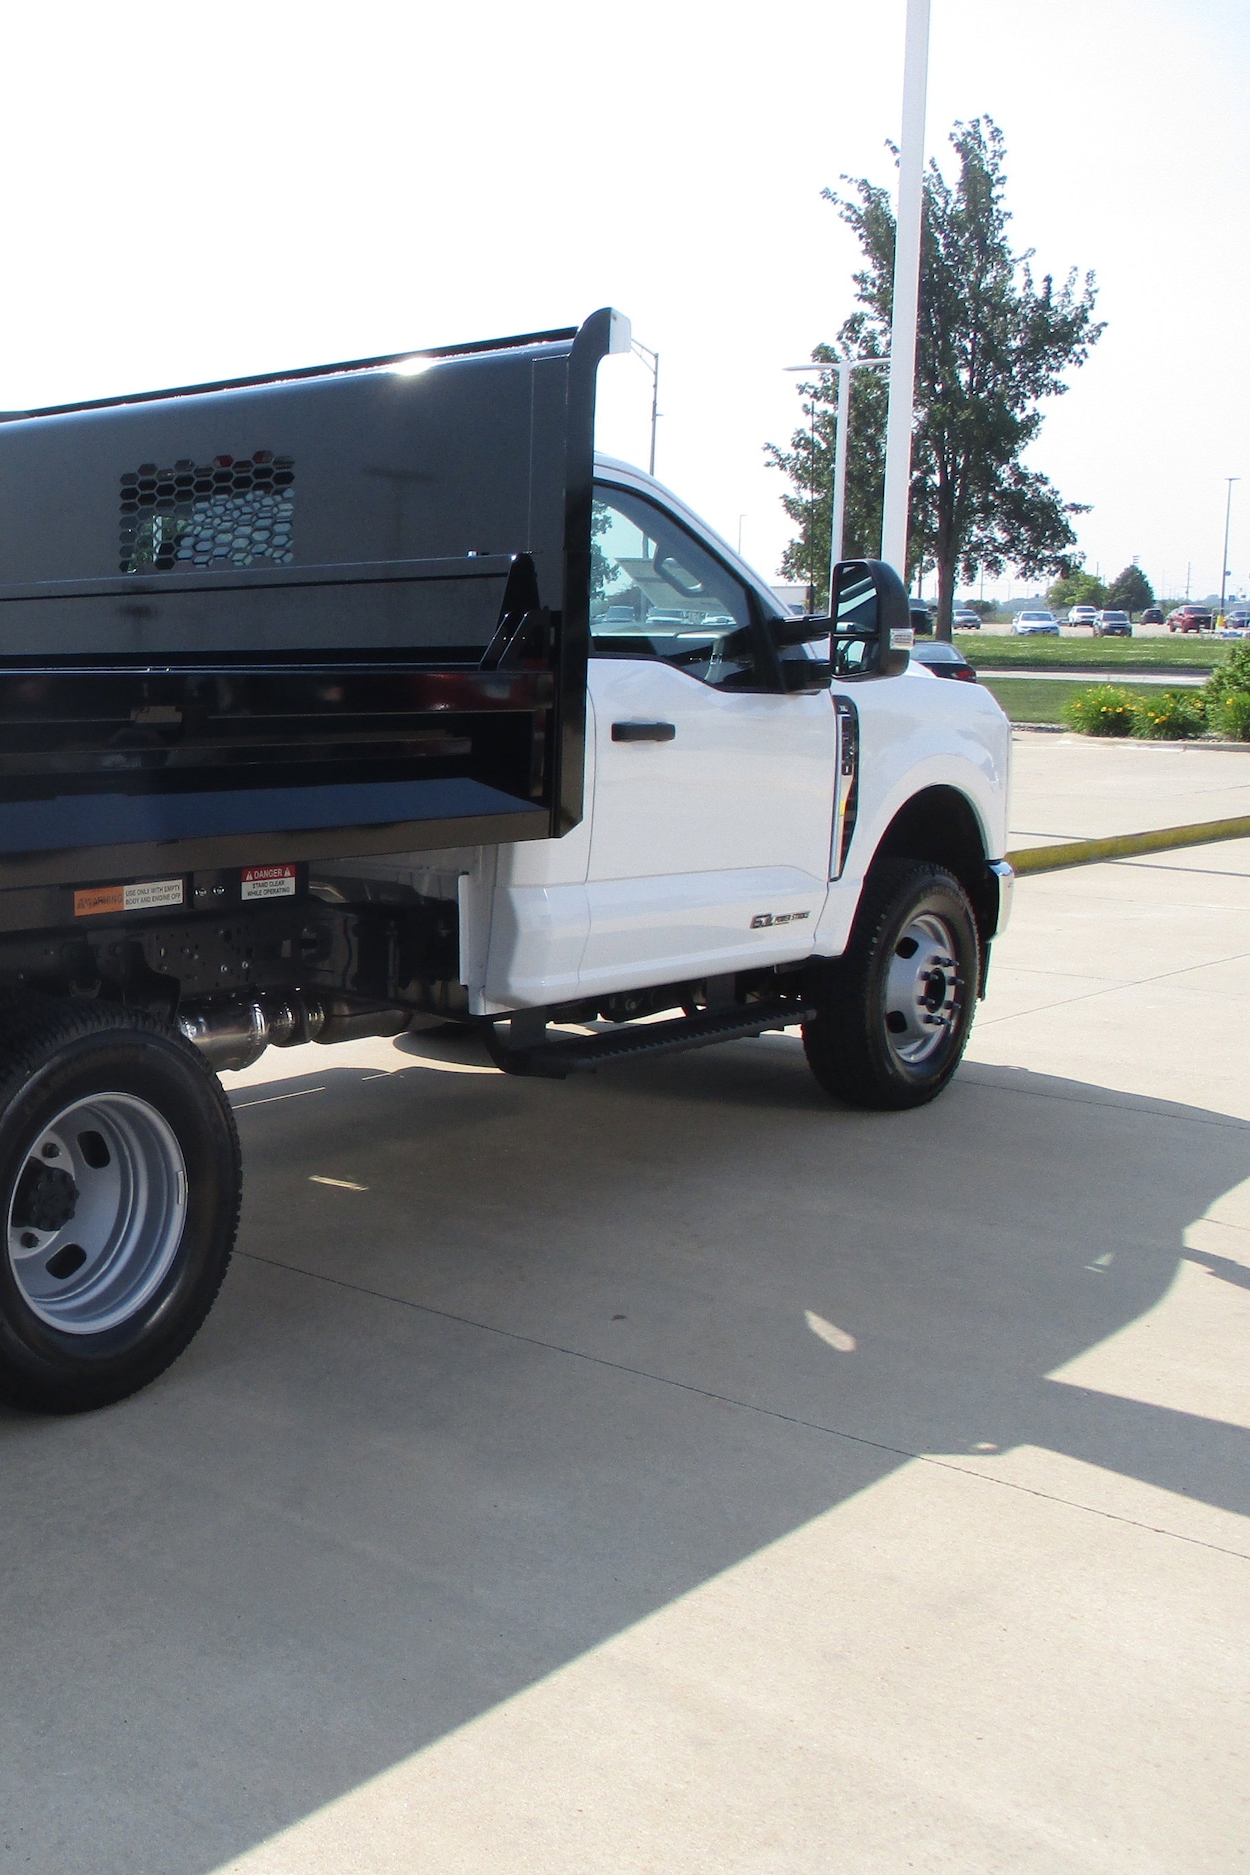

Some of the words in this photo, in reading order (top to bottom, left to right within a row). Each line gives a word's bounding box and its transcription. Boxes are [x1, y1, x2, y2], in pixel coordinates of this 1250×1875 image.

[254, 869, 283, 879] DANGER
[137, 887, 150, 895] ONLY
[164, 884, 180, 892] EMPTY
[247, 889, 262, 897] WHILE
[263, 887, 290, 895] OPERATING
[126, 897, 139, 905] BODY
[152, 894, 170, 902] ENGINE
[171, 892, 181, 900] OFF
